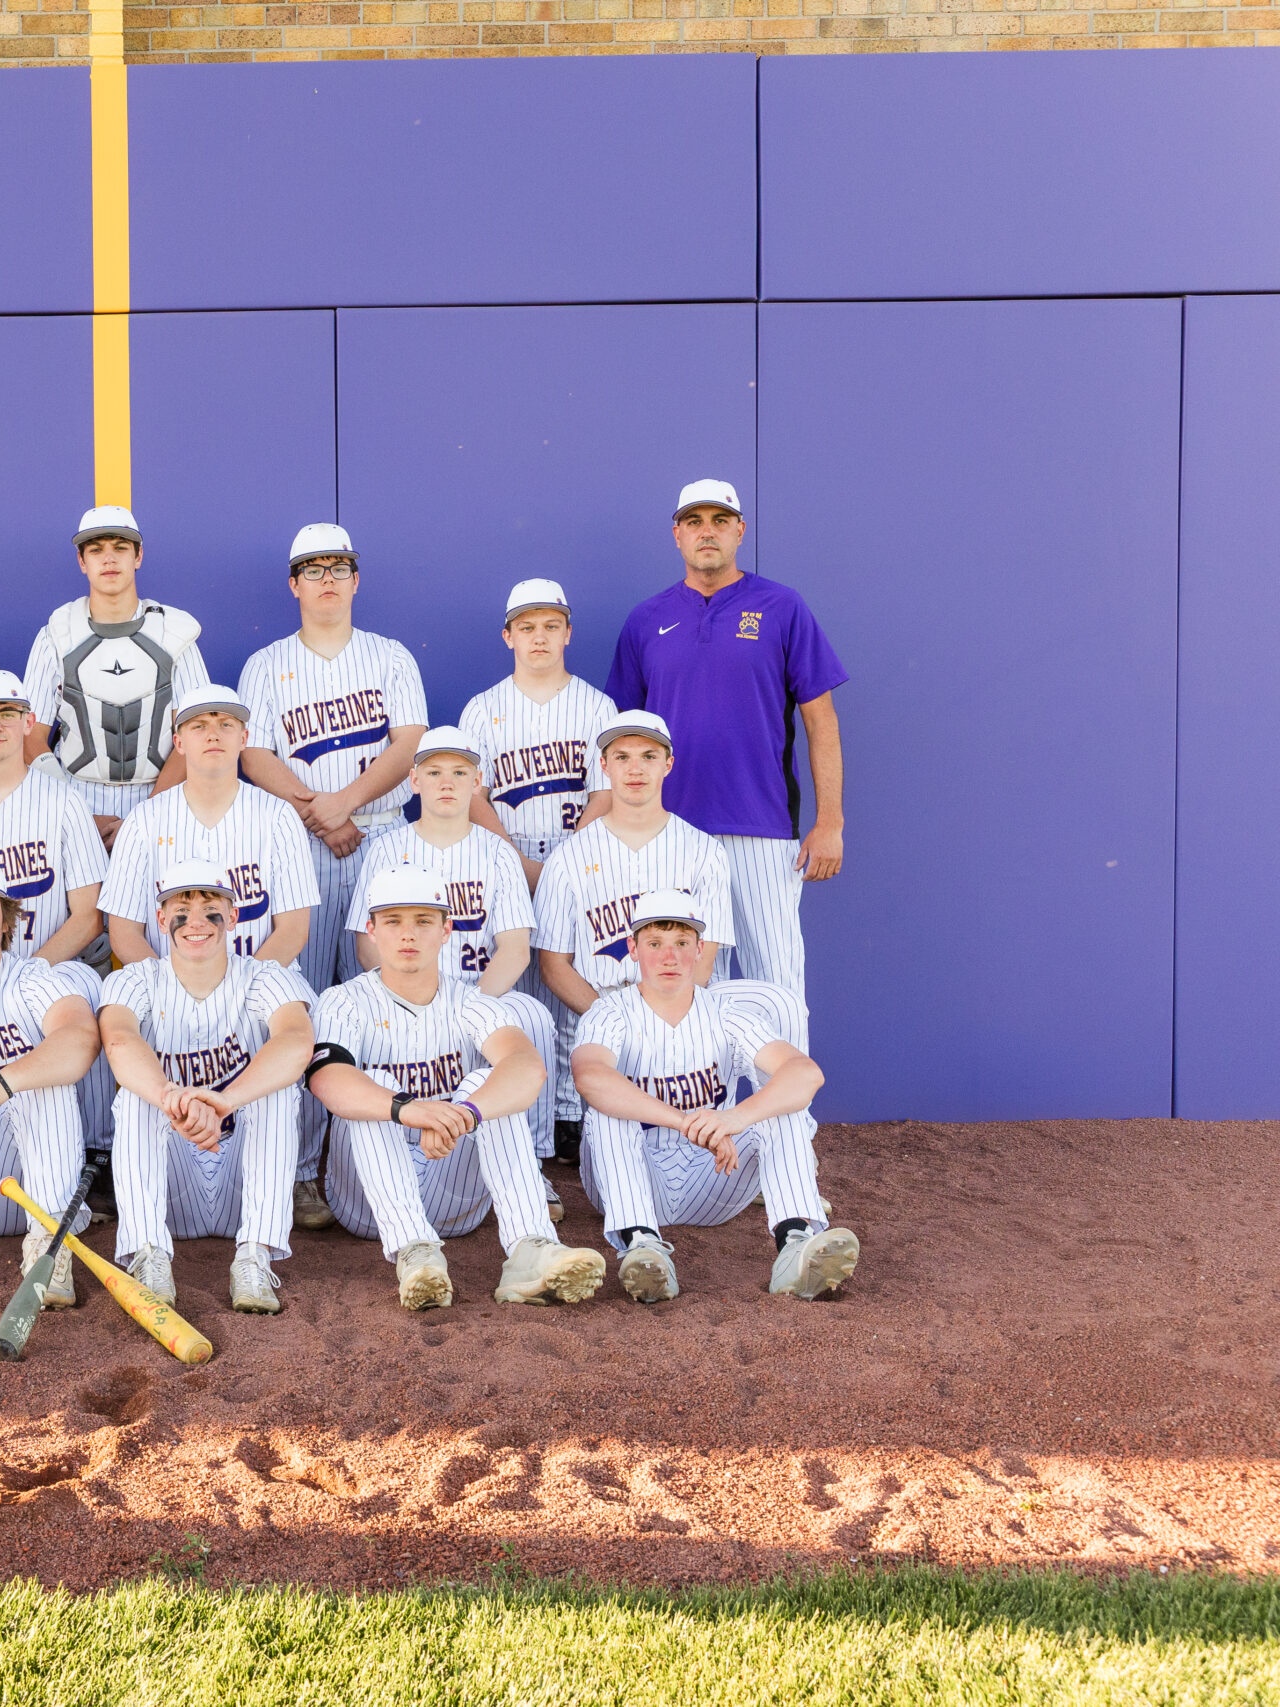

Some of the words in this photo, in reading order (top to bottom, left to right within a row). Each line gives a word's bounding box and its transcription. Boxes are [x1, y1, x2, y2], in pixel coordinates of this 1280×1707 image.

[281, 689, 384, 745] WOLVERINES
[358, 757, 377, 776] 1
[21, 911, 36, 940] 7
[233, 935, 253, 957] 11
